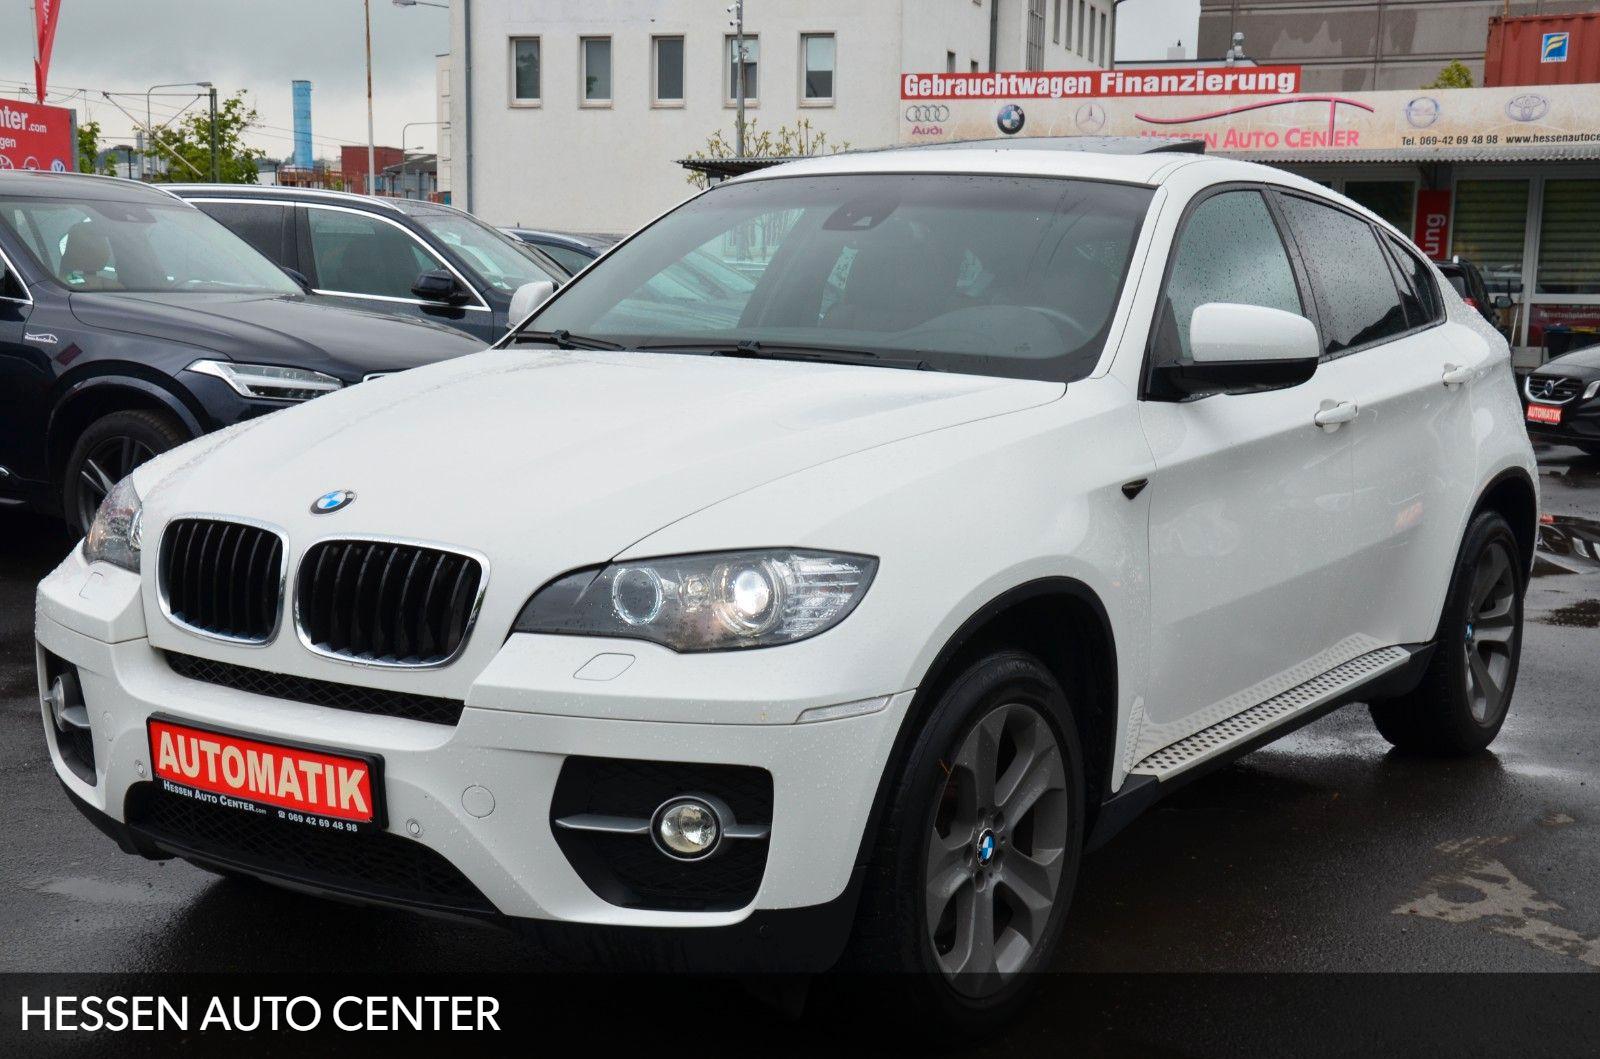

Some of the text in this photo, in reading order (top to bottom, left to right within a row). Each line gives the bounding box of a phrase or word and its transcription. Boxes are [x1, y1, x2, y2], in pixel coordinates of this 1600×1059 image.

[904, 70, 1295, 98] Gebrauchtwagen Finanzierung
[911, 126, 943, 135] Audi
[1223, 128, 1279, 149] AUTO
[1456, 135, 1468, 145] 69
[1471, 135, 1483, 144] 48
[1486, 134, 1498, 144] 98
[158, 730, 368, 813] AUTOMATIK
[163, 780, 193, 797] HESSEN
[194, 789, 217, 804] AUTO
[288, 812, 358, 832] 069 42 69 48 98
